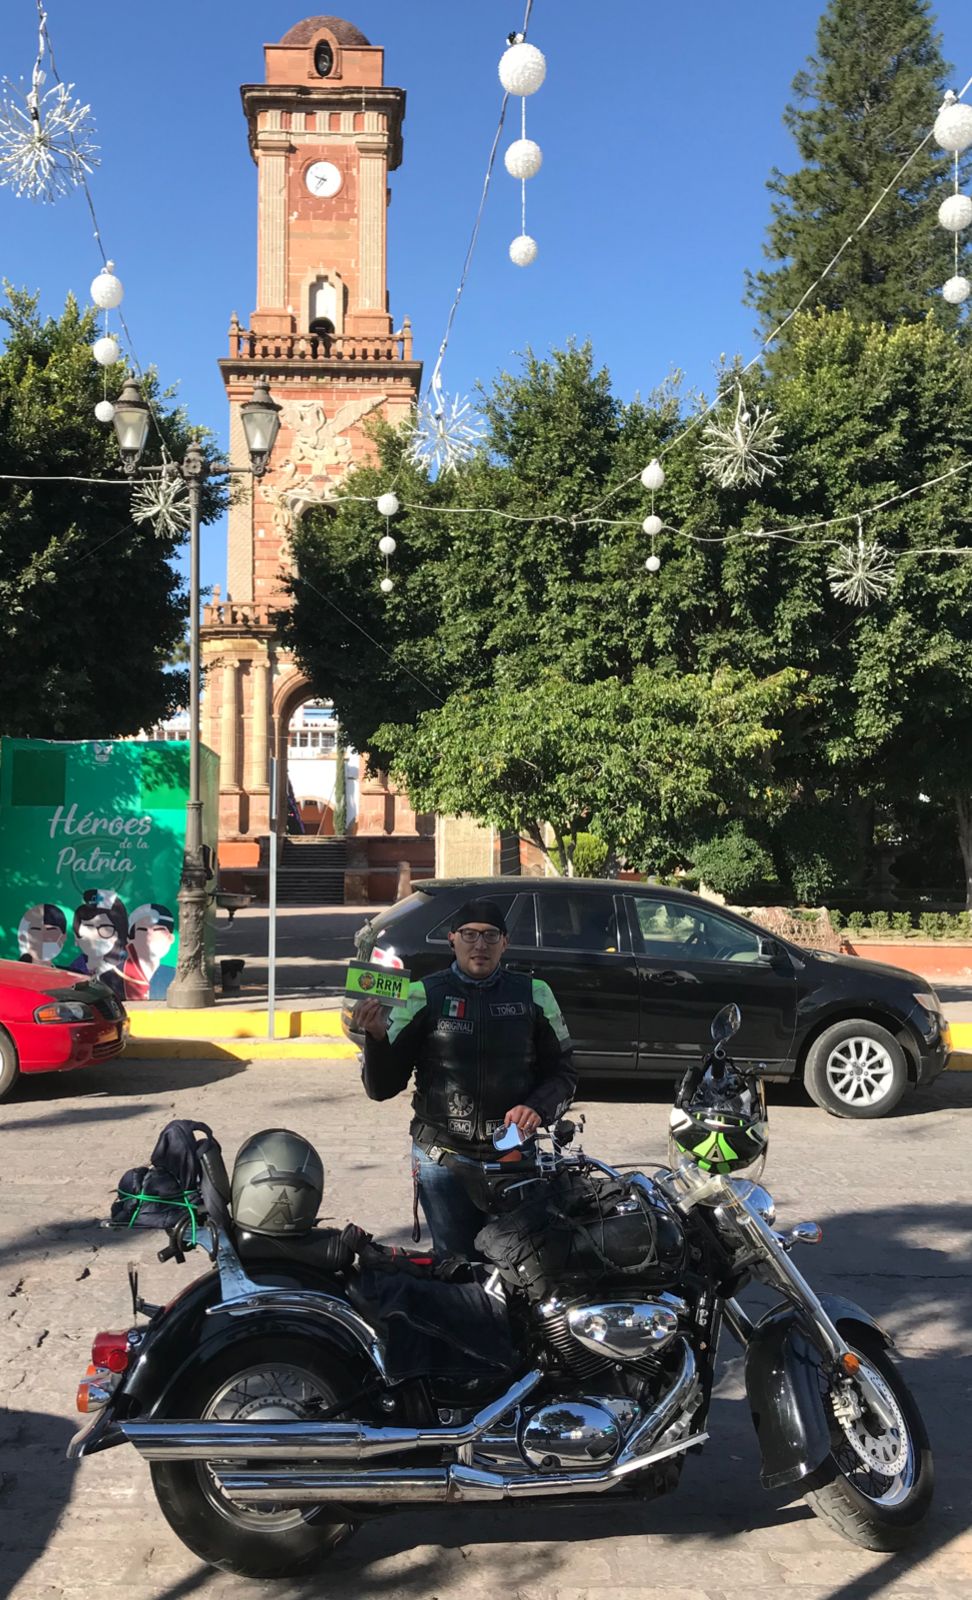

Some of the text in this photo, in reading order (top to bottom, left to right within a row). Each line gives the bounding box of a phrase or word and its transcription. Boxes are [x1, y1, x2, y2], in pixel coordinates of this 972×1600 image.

[48, 803, 152, 838] Héroes
[119, 837, 149, 849] de la
[56, 847, 136, 875] Patria
[376, 978, 402, 993] RRM
[440, 1020, 472, 1033] ORIGINAL
[449, 1120, 470, 1134] CRMC
